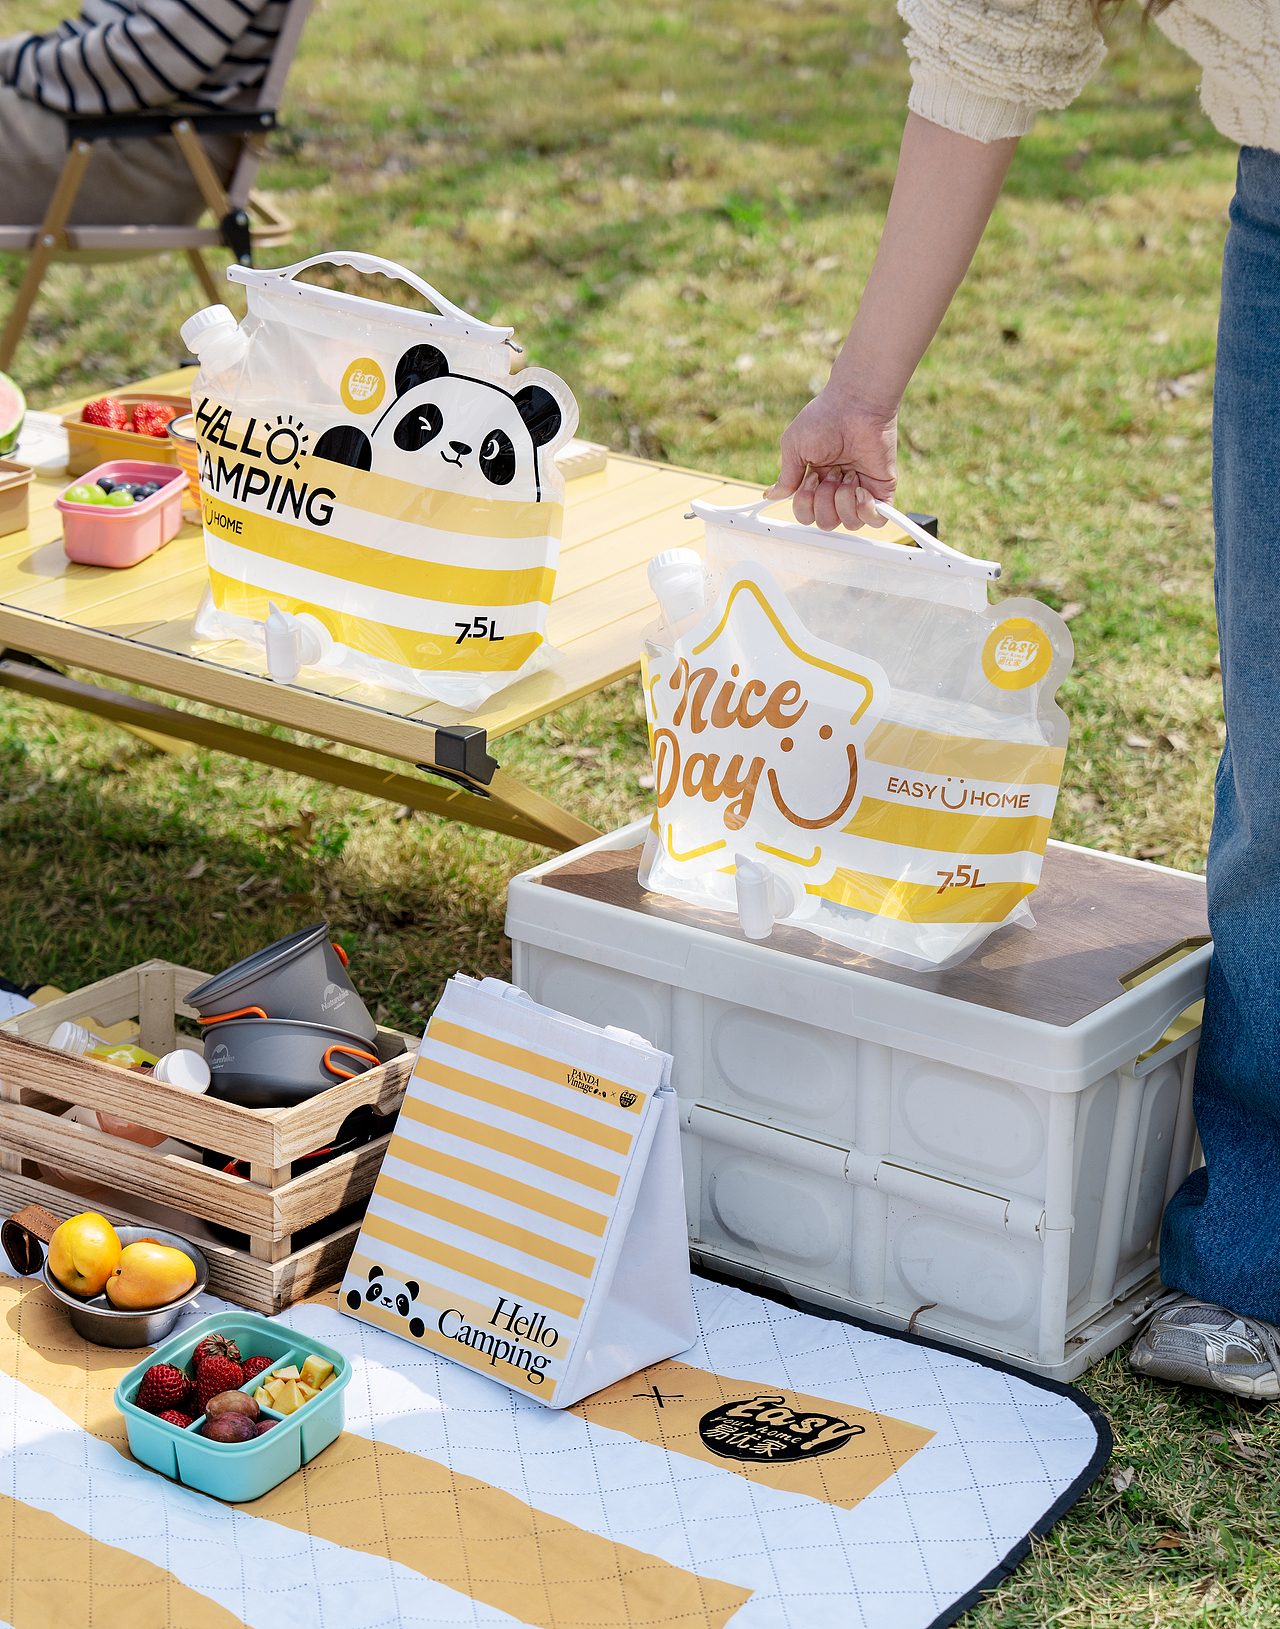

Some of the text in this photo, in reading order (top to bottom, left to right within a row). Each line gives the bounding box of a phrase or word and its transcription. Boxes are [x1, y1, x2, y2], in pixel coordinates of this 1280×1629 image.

[197, 443, 337, 527] AMPING
[454, 616, 505, 645] 7.5L
[669, 656, 809, 735] Nice
[653, 727, 766, 832] Day
[936, 864, 986, 895] 7.5L
[566, 1073, 593, 1095] Vintage
[571, 1068, 599, 1087] PANDA
[488, 1296, 559, 1348] Hello
[438, 1308, 552, 1385] Camping
[703, 1424, 788, 1458] 易优家
[709, 1415, 802, 1444] your home
[726, 1396, 864, 1451] Easy
